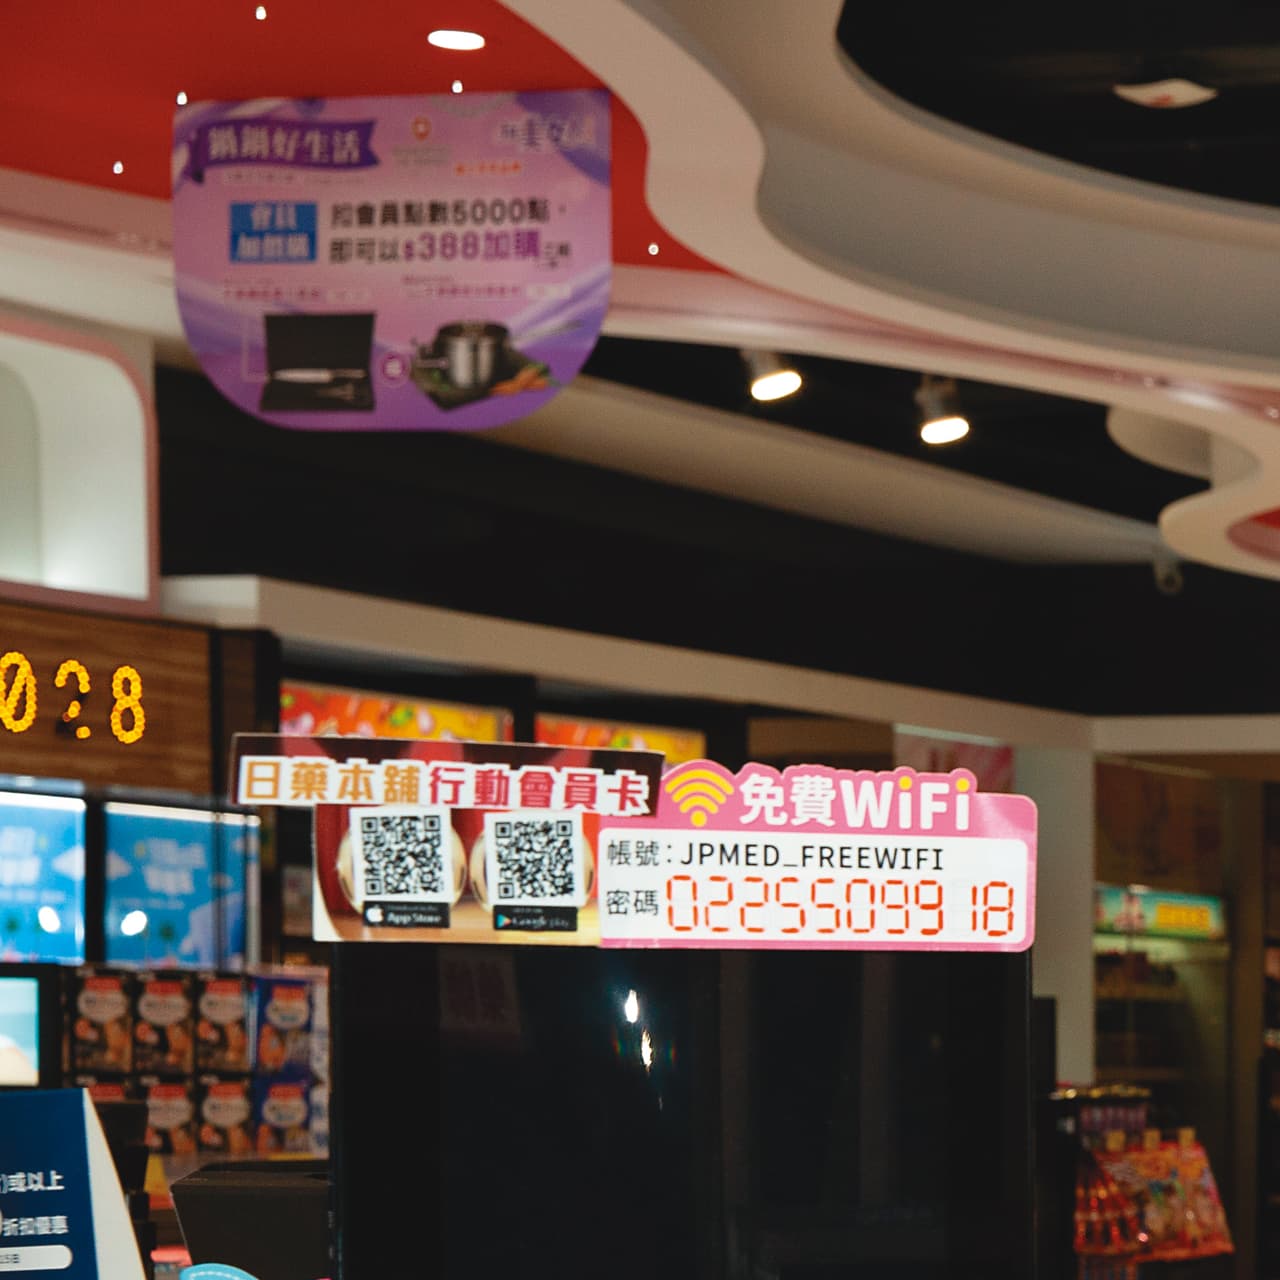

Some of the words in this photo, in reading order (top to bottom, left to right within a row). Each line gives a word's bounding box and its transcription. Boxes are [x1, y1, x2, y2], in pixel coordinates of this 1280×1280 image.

[244, 757, 653, 815] 日藥本舖行動會員卡
[606, 888, 660, 917] 密碼
